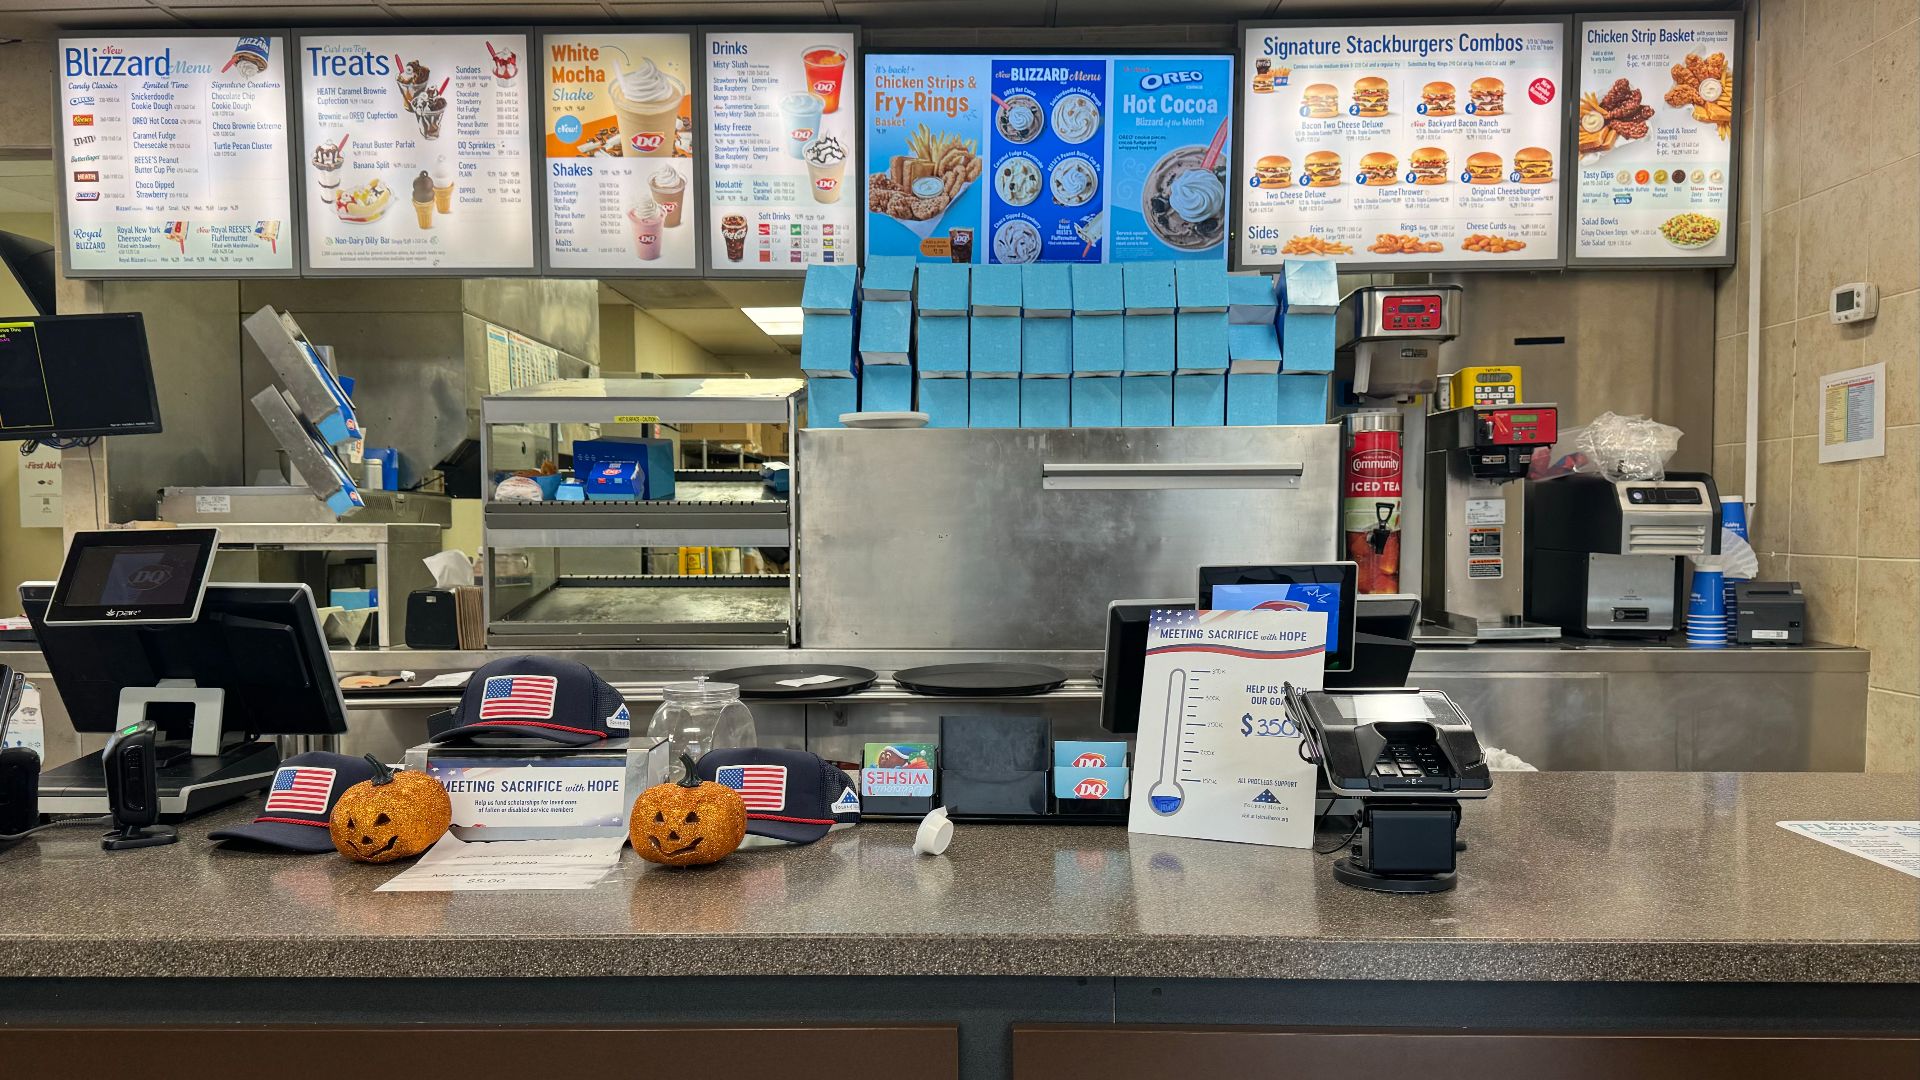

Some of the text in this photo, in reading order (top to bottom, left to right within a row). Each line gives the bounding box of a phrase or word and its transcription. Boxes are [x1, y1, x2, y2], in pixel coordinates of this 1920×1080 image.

[1588, 28, 1694, 45] Chicken Strip Basket
[712, 41, 748, 55] Drinks
[1263, 32, 1523, 60] Signature Stackburgers Combos
[552, 43, 599, 62] White
[66, 48, 170, 77] Blizzard
[306, 47, 390, 77] Treats
[713, 61, 729, 69] Misty
[169, 61, 212, 74] Menu
[456, 66, 481, 74] Sundaes
[552, 66, 605, 83] Mocha
[1011, 67, 1069, 82] BLIZZARD
[1069, 70, 1101, 81] Menu
[875, 75, 977, 92] Chicken Strips &
[1141, 71, 1203, 90] OREO
[68, 82, 90, 91] Candy
[338, 87, 362, 95] Caramel
[363, 87, 386, 95] Brownie
[212, 92, 255, 101] Chocolate Chip
[552, 88, 595, 101] Shake
[132, 102, 173, 111] Cookie Dough
[317, 97, 349, 106] Cupfection
[875, 90, 969, 118] Fry-Rings
[1123, 94, 1218, 114] Hot Cocoa
[875, 117, 906, 126] Basket
[1136, 118, 1204, 128] Blizzard of the Month
[714, 123, 751, 131] Misty Freeze
[133, 132, 176, 141] Caramel Fudge
[637, 136, 661, 147] DQ
[214, 142, 272, 150] Turtle Pecan Cluster
[458, 141, 495, 150] DQ Sprinkles
[376, 161, 390, 170] Split
[553, 163, 593, 177] Shakes
[1583, 171, 1614, 179] Tasty Dips
[136, 181, 174, 190] Choco Dipped
[136, 191, 168, 200] Strawberry
[1280, 191, 1303, 199] Cheese
[773, 213, 790, 221] Drinks
[1582, 217, 1618, 225] Salad Bowls
[1310, 225, 1324, 233] Fries
[1401, 223, 1417, 231] Rings
[1490, 222, 1507, 230] Curds
[73, 229, 102, 239] Royal
[1249, 226, 1279, 240] Sides
[335, 237, 364, 245] Non-Dairy
[366, 237, 379, 245] Dilly
[556, 239, 572, 247] Malts
[28, 461, 56, 469] First Aid
[1353, 458, 1399, 471] Community
[1351, 481, 1400, 492] ICED TEA
[1160, 629, 1307, 642] MEETING SACRIFICE with HOPE
[1246, 684, 1307, 695] HELP US RCH
[1251, 696, 1268, 705] OUR
[1241, 713, 1253, 737] $
[1078, 758, 1102, 767] DQ
[867, 771, 929, 785] WISHES
[1248, 778, 1273, 787] PROCEEDS
[1274, 780, 1297, 788] SUPPORT
[501, 780, 563, 792] SACRIFICE
[565, 783, 586, 793] with
[587, 780, 619, 792] HOPE
[1078, 783, 1103, 797] DQ
